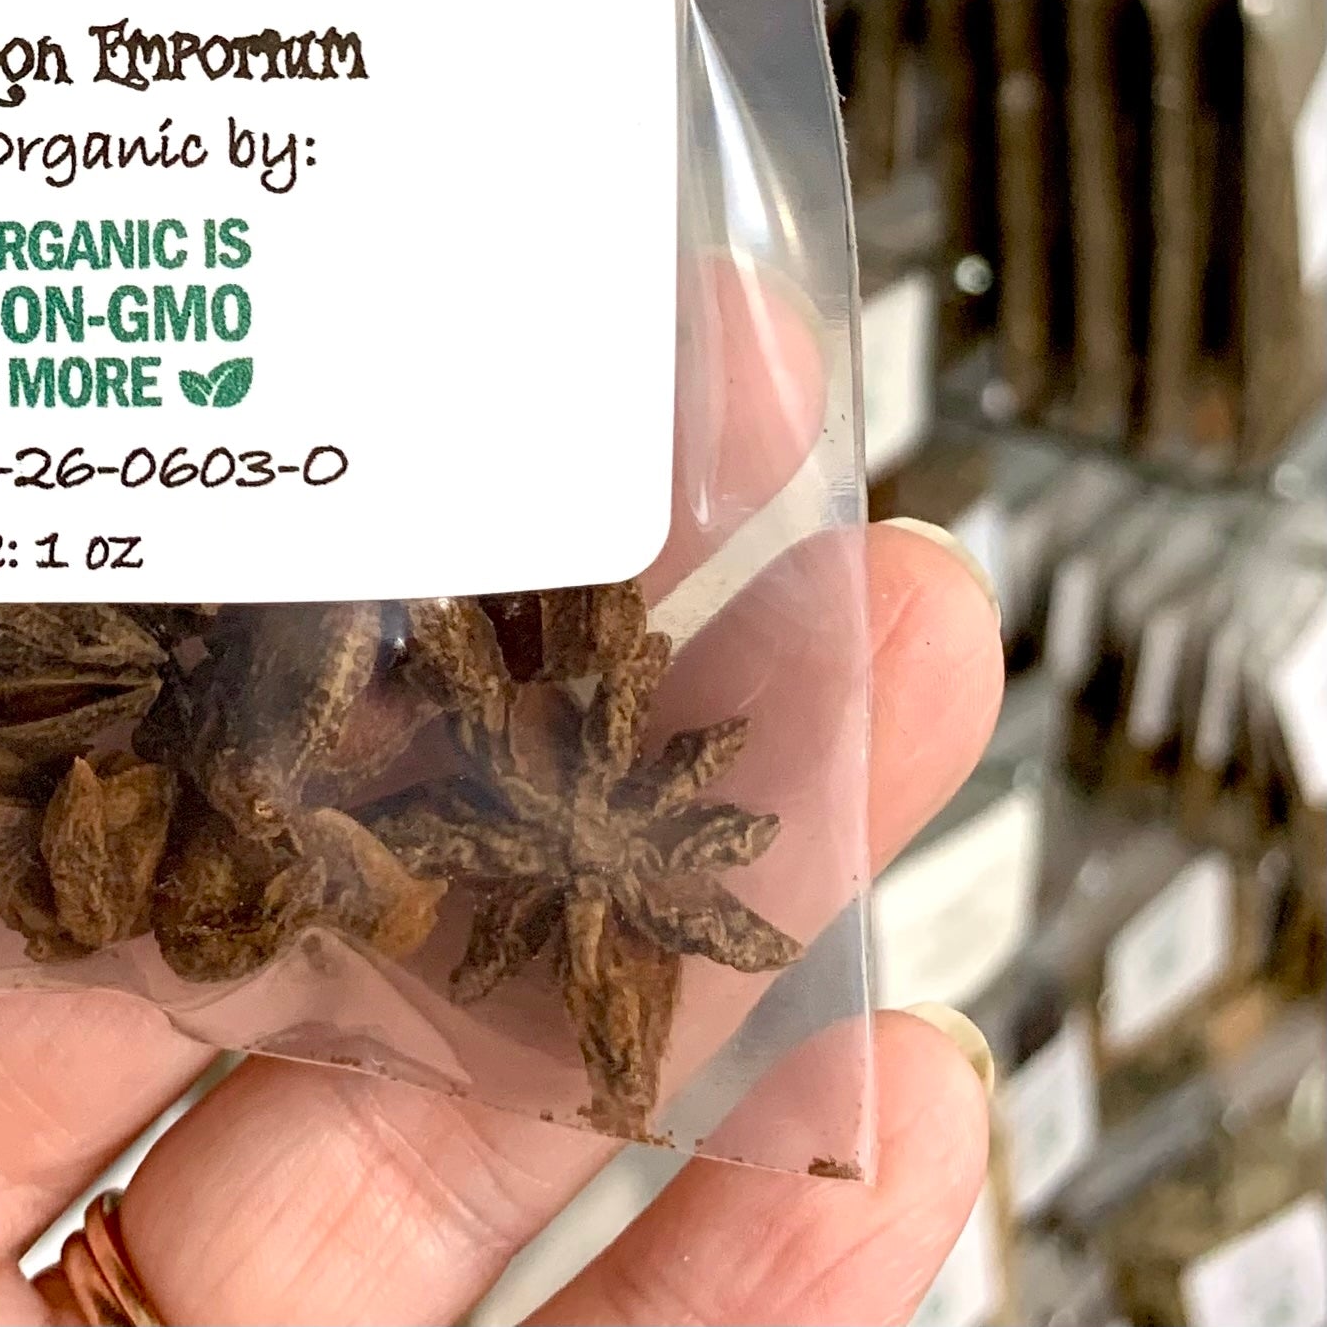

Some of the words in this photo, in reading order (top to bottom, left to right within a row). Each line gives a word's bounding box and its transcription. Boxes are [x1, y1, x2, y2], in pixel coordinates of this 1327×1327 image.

[227, 115, 317, 195] by:
[203, 217, 252, 270] IS
[8, 355, 163, 409] MORE
[34, 532, 70, 569] 1
[85, 535, 144, 571] oz
